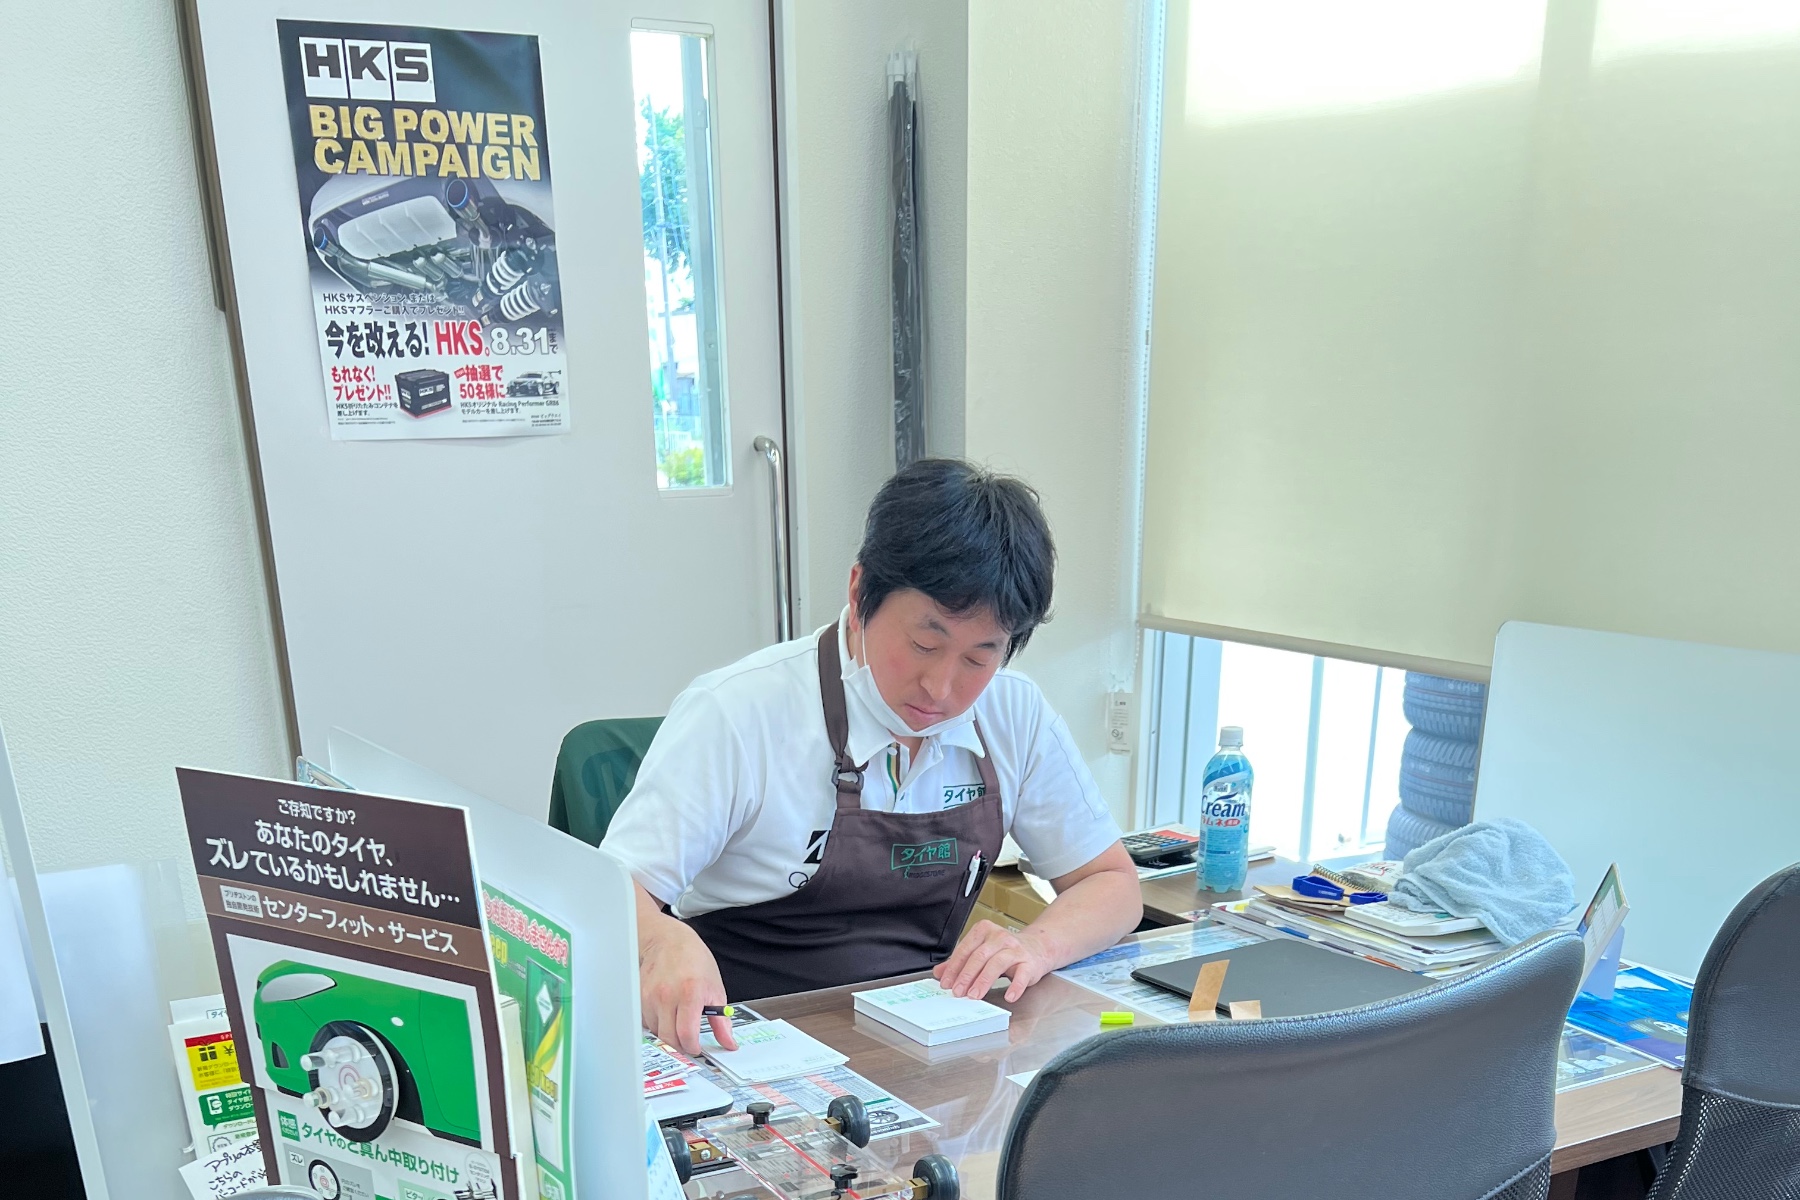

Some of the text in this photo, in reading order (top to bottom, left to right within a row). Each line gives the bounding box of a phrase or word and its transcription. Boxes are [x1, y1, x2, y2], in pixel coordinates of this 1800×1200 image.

[303, 43, 430, 82] HKS
[308, 104, 539, 147] BIG POWER
[313, 138, 541, 181] CAMPAIGN
[331, 366, 376, 383] もれなく!
[333, 384, 392, 401] プレゼント!!
[460, 384, 506, 400] 50名様に
[277, 798, 356, 825] ご存知ですか?
[255, 820, 394, 866] あなたのタイヤ、
[900, 843, 951, 862] タイヤ館
[262, 896, 459, 956] センターフィット・サービス
[290, 1153, 303, 1164] ズレ
